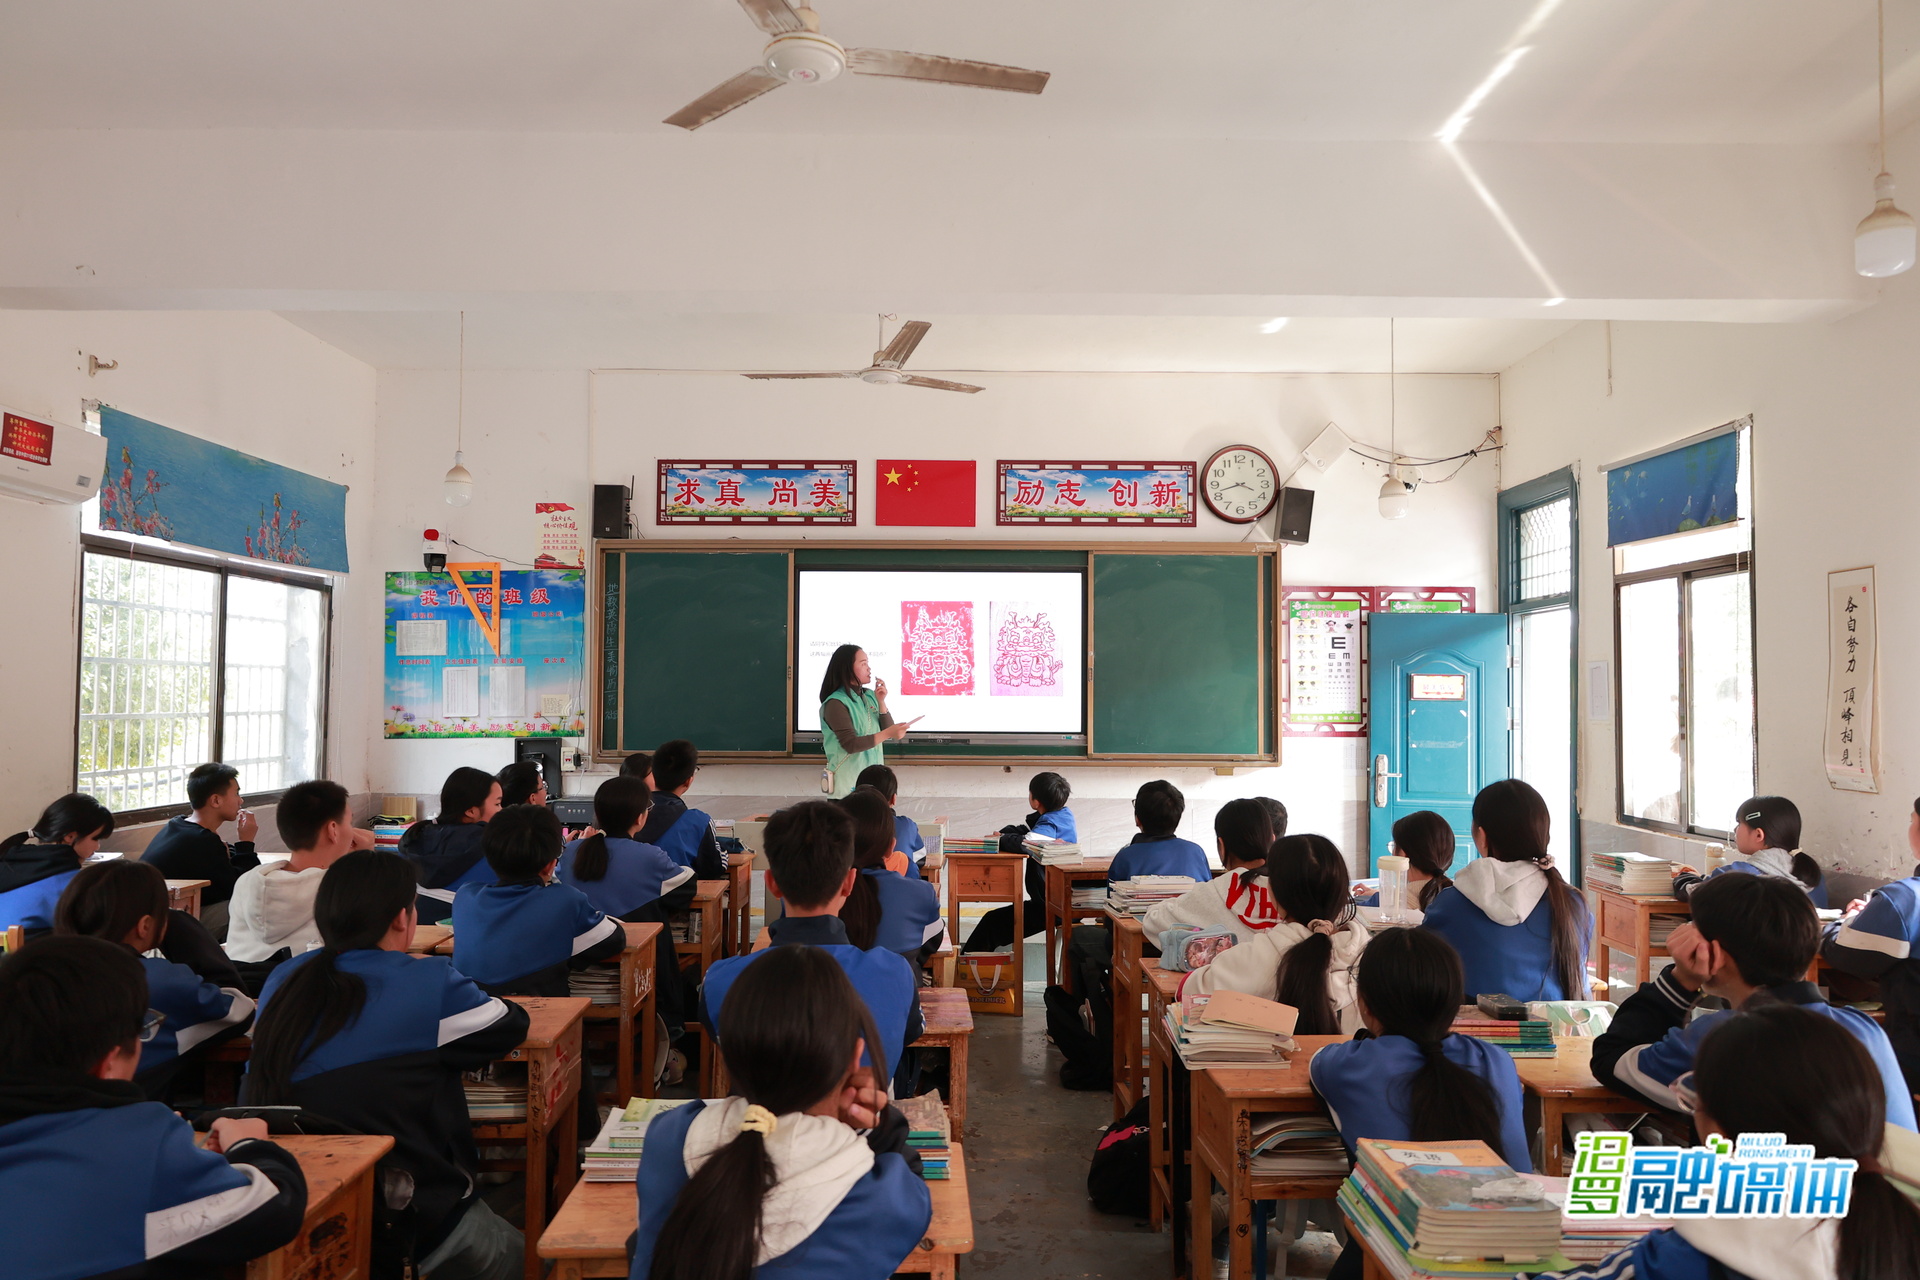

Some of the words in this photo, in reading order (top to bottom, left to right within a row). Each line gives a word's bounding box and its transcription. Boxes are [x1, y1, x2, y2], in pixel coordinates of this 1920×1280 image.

[1234, 455, 1246, 463] 12
[1250, 459, 1254, 468] 1
[1224, 460, 1231, 468] 11
[1214, 469, 1225, 478] 10
[1256, 468, 1266, 477] 2
[1210, 480, 1220, 490] 9
[1260, 480, 1270, 489] 3
[673, 478, 745, 506] 求真
[768, 478, 841, 507] 尚美
[1013, 480, 1086, 507] 励志
[1108, 480, 1182, 508] 创新
[1214, 492, 1223, 501] 8
[1258, 492, 1266, 500] 4
[1224, 501, 1232, 510] 7
[1248, 500, 1258, 510] 5
[1236, 506, 1245, 514] 6
[420, 588, 551, 606] 我们的班级
[1844, 596, 1859, 673] 各自努力
[418, 724, 444, 732] 求真
[454, 724, 480, 732] 尚美
[490, 724, 516, 732] 励志
[526, 723, 550, 732] 创新
